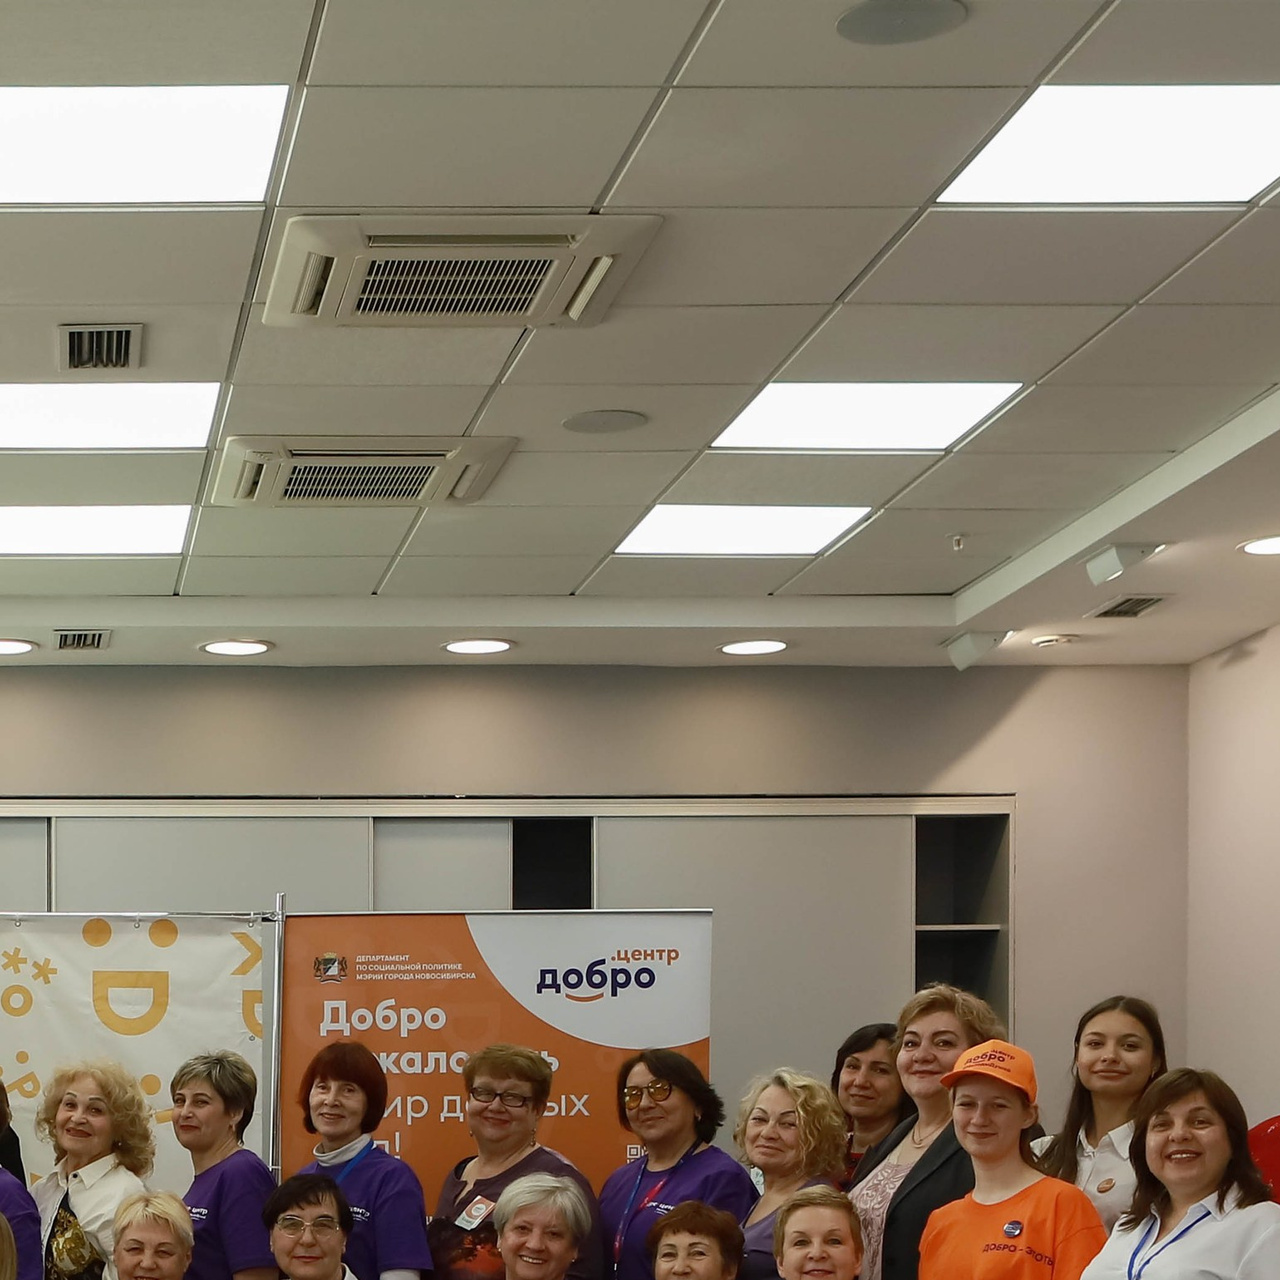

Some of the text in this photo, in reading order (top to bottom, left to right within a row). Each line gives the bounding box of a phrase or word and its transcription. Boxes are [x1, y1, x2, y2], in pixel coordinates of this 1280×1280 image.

[368, 963, 421, 971] СОЦИАЛЬНОЙ
[415, 972, 477, 980] НОВОСИБИРСКА
[536, 958, 656, 997] добро
[320, 998, 447, 1038] Добро
[982, 1242, 1017, 1253] ДОБРО
